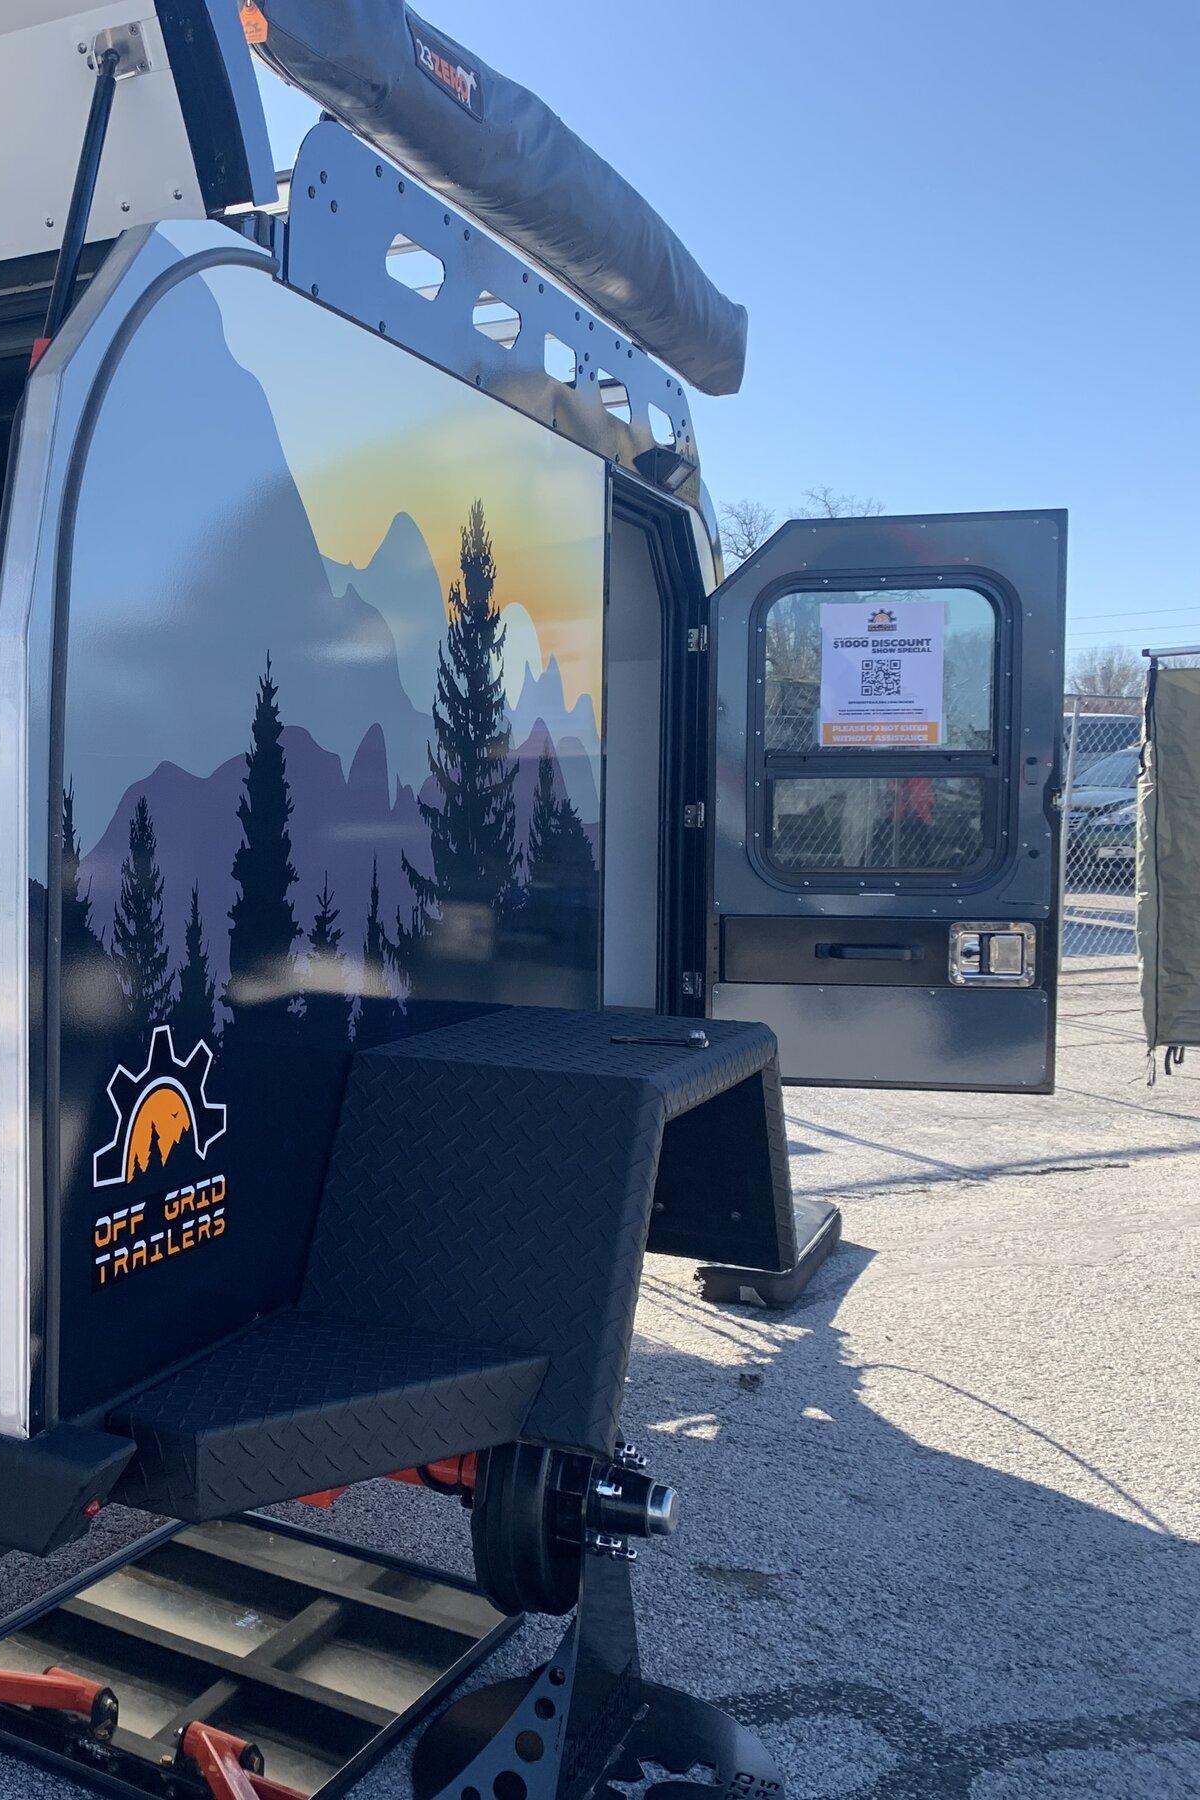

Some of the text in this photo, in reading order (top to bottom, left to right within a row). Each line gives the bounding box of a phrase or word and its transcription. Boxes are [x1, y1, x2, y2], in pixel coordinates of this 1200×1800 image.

[833, 640, 869, 649] $1000
[871, 638, 932, 648] DISCOUNT
[95, 1174, 226, 1248] OFF GRID
[95, 1207, 226, 1284] TRAILERS
